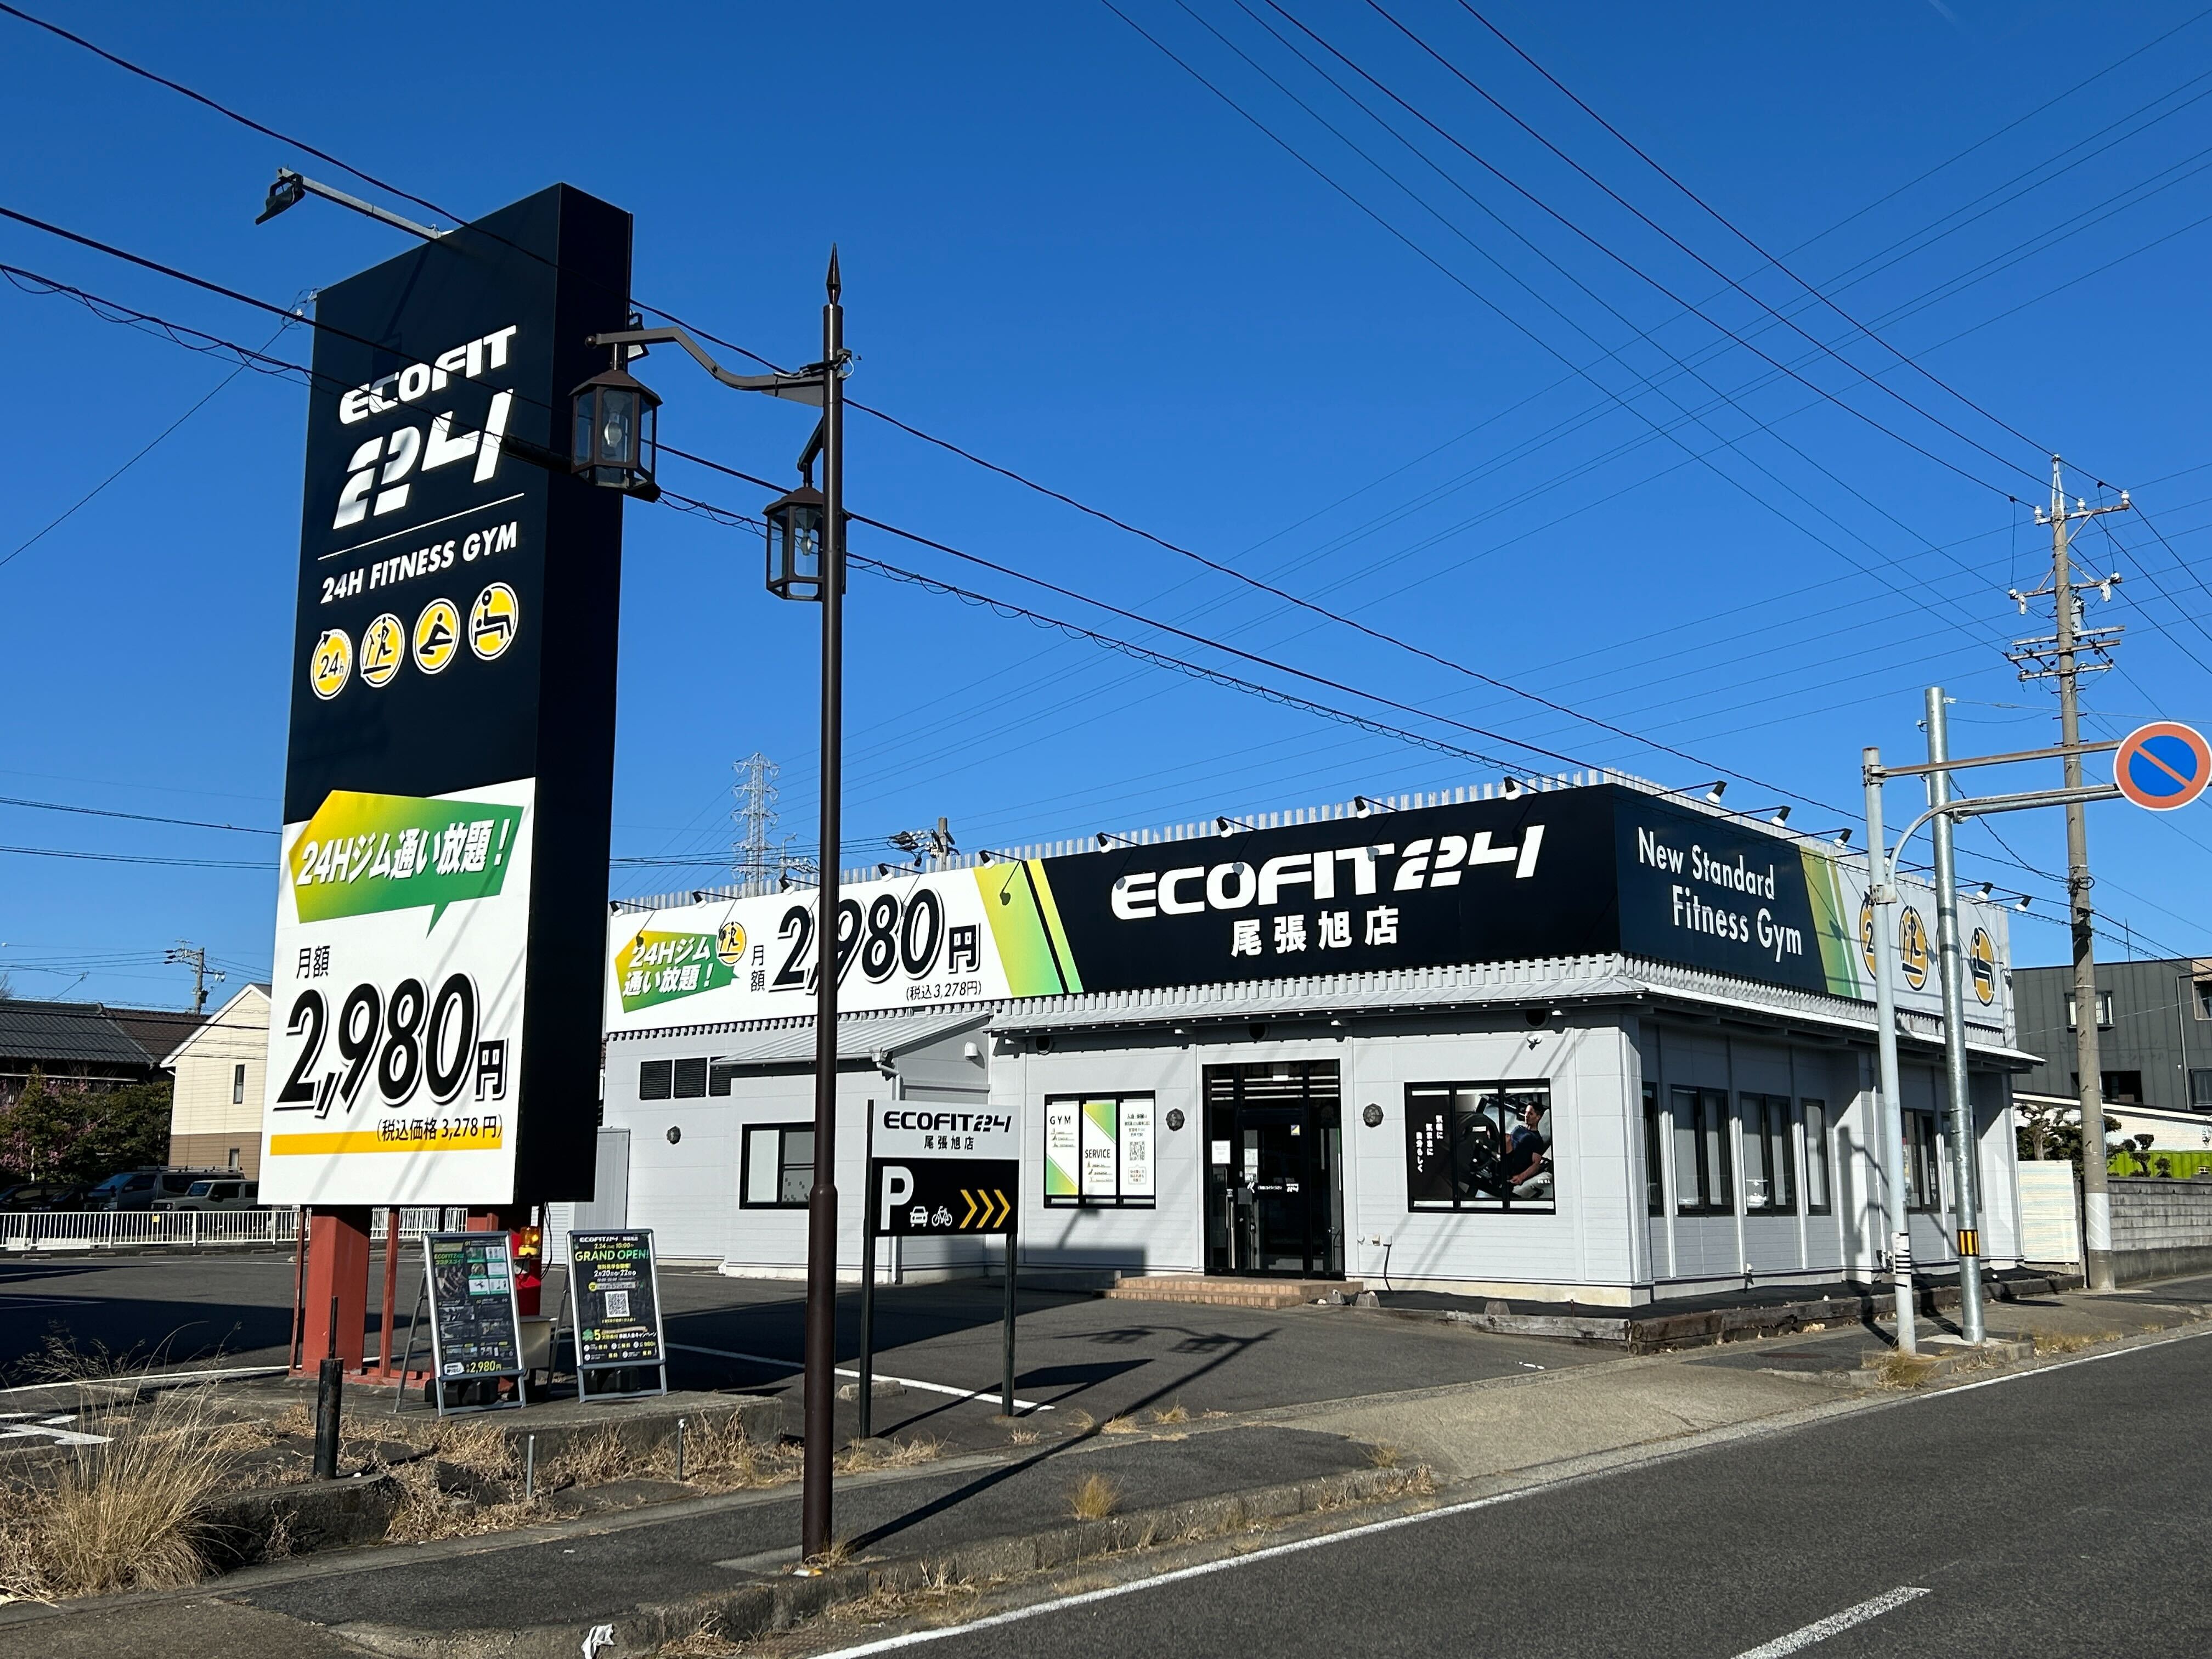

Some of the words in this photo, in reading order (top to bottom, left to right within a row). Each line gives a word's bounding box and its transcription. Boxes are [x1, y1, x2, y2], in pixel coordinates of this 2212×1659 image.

[339, 325, 516, 424] ECOFIT
[332, 388, 514, 529] 24
[320, 564, 363, 605] 24H
[369, 544, 454, 590] FITNESS
[463, 521, 517, 561] GYM
[1111, 824, 1545, 921] ECOFIT24
[1638, 826, 1684, 875] New
[1692, 843, 1776, 901] Standard
[1231, 905, 1398, 958] 尾張旭店
[1672, 884, 1750, 943] Fitness
[1757, 908, 1803, 963] Gym
[296, 946, 330, 979] 月額
[629, 936, 710, 968] 24Hジム
[751, 944, 765, 992] 月額
[883, 1110, 1012, 1133] ECOFIT24
[924, 1135, 974, 1150] 尾張旭店
[1049, 1115, 1071, 1125] GYM
[1085, 1149, 1111, 1159] SERVICE
[881, 1166, 914, 1230] P
[574, 1250, 616, 1262] GRAND
[617, 1249, 649, 1260] OPEN!
